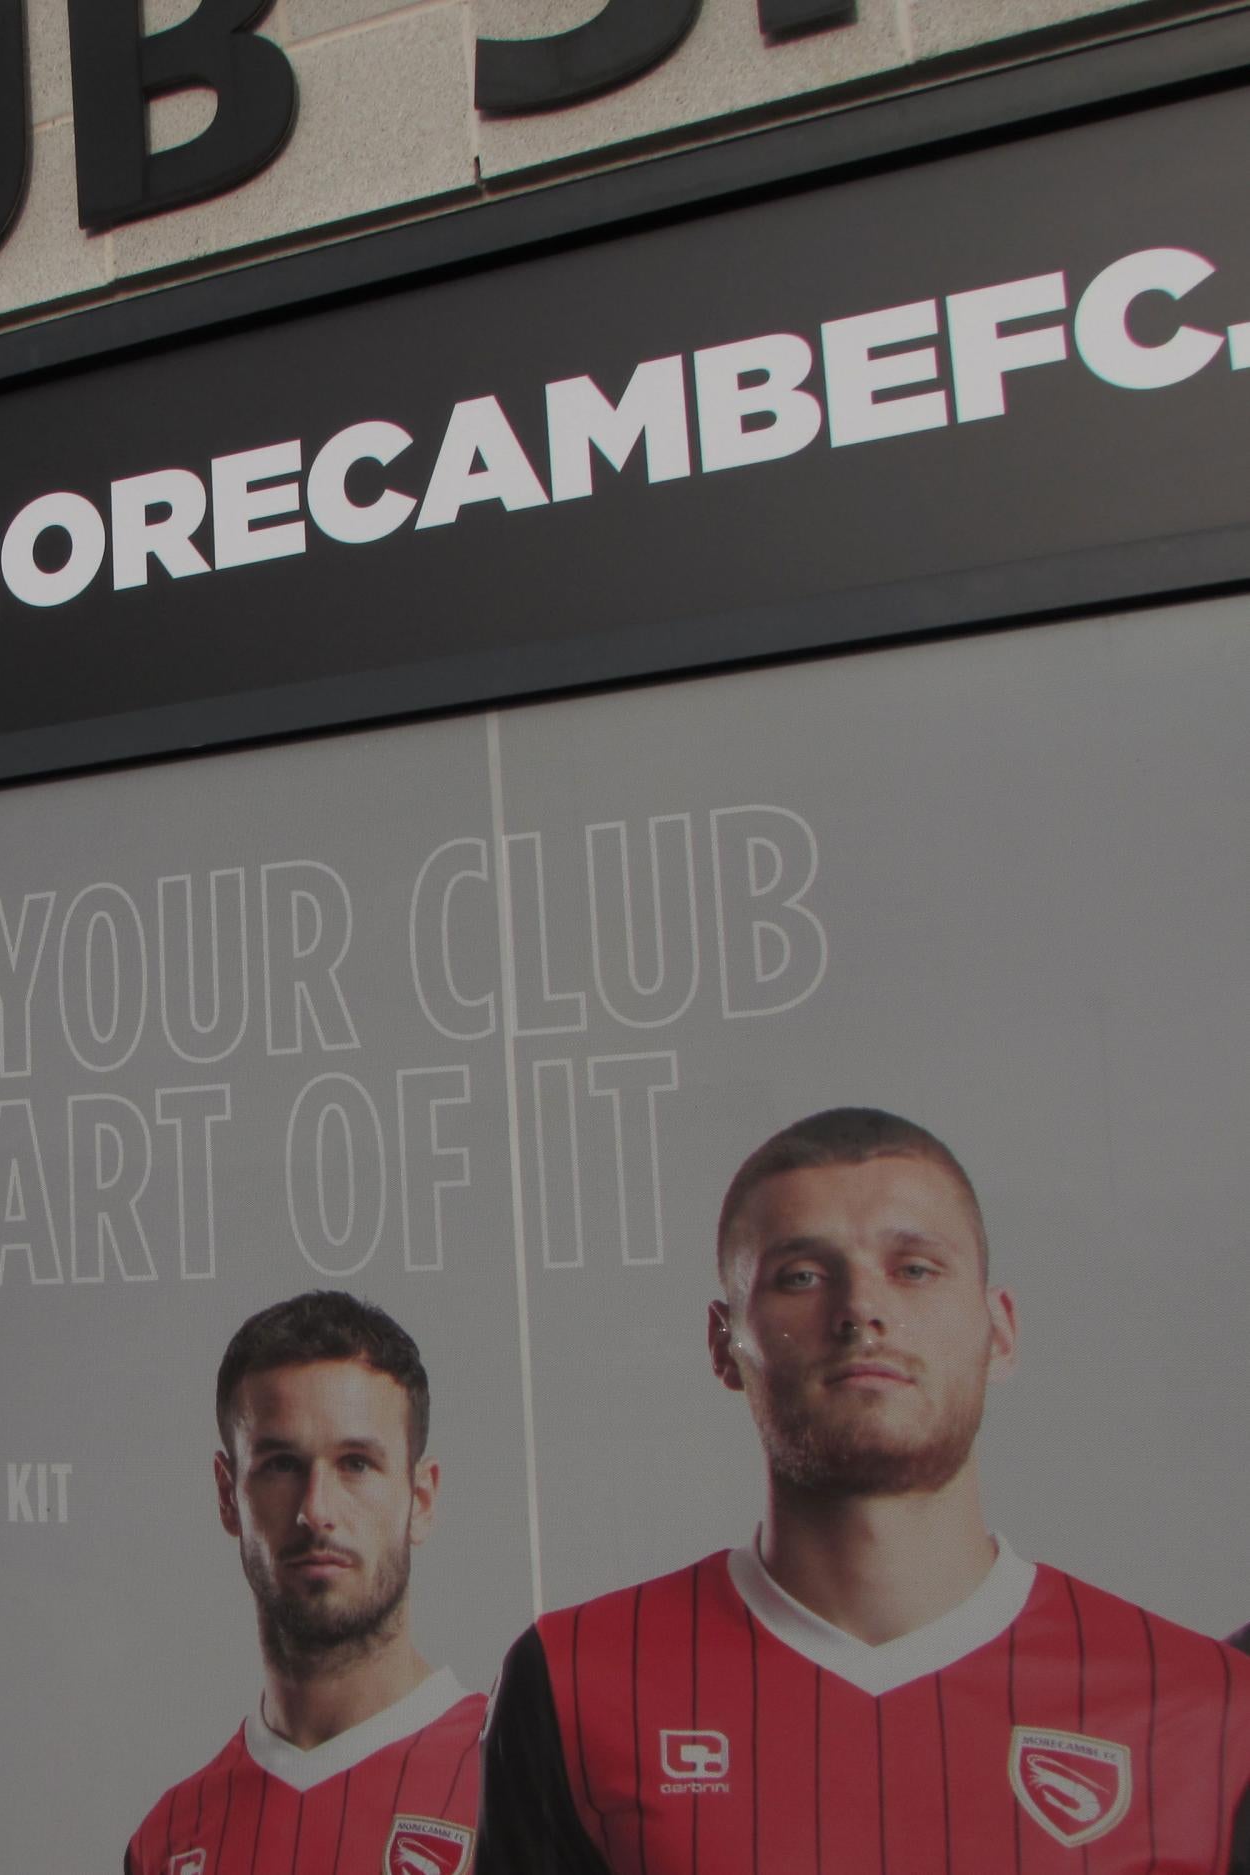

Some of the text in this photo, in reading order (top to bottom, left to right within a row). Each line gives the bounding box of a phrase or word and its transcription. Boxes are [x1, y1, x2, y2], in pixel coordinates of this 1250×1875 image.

[409, 804, 828, 1041] CLUB
[286, 1064, 471, 1278] OF
[532, 1051, 678, 1270] IT
[7, 1462, 72, 1524] KIT
